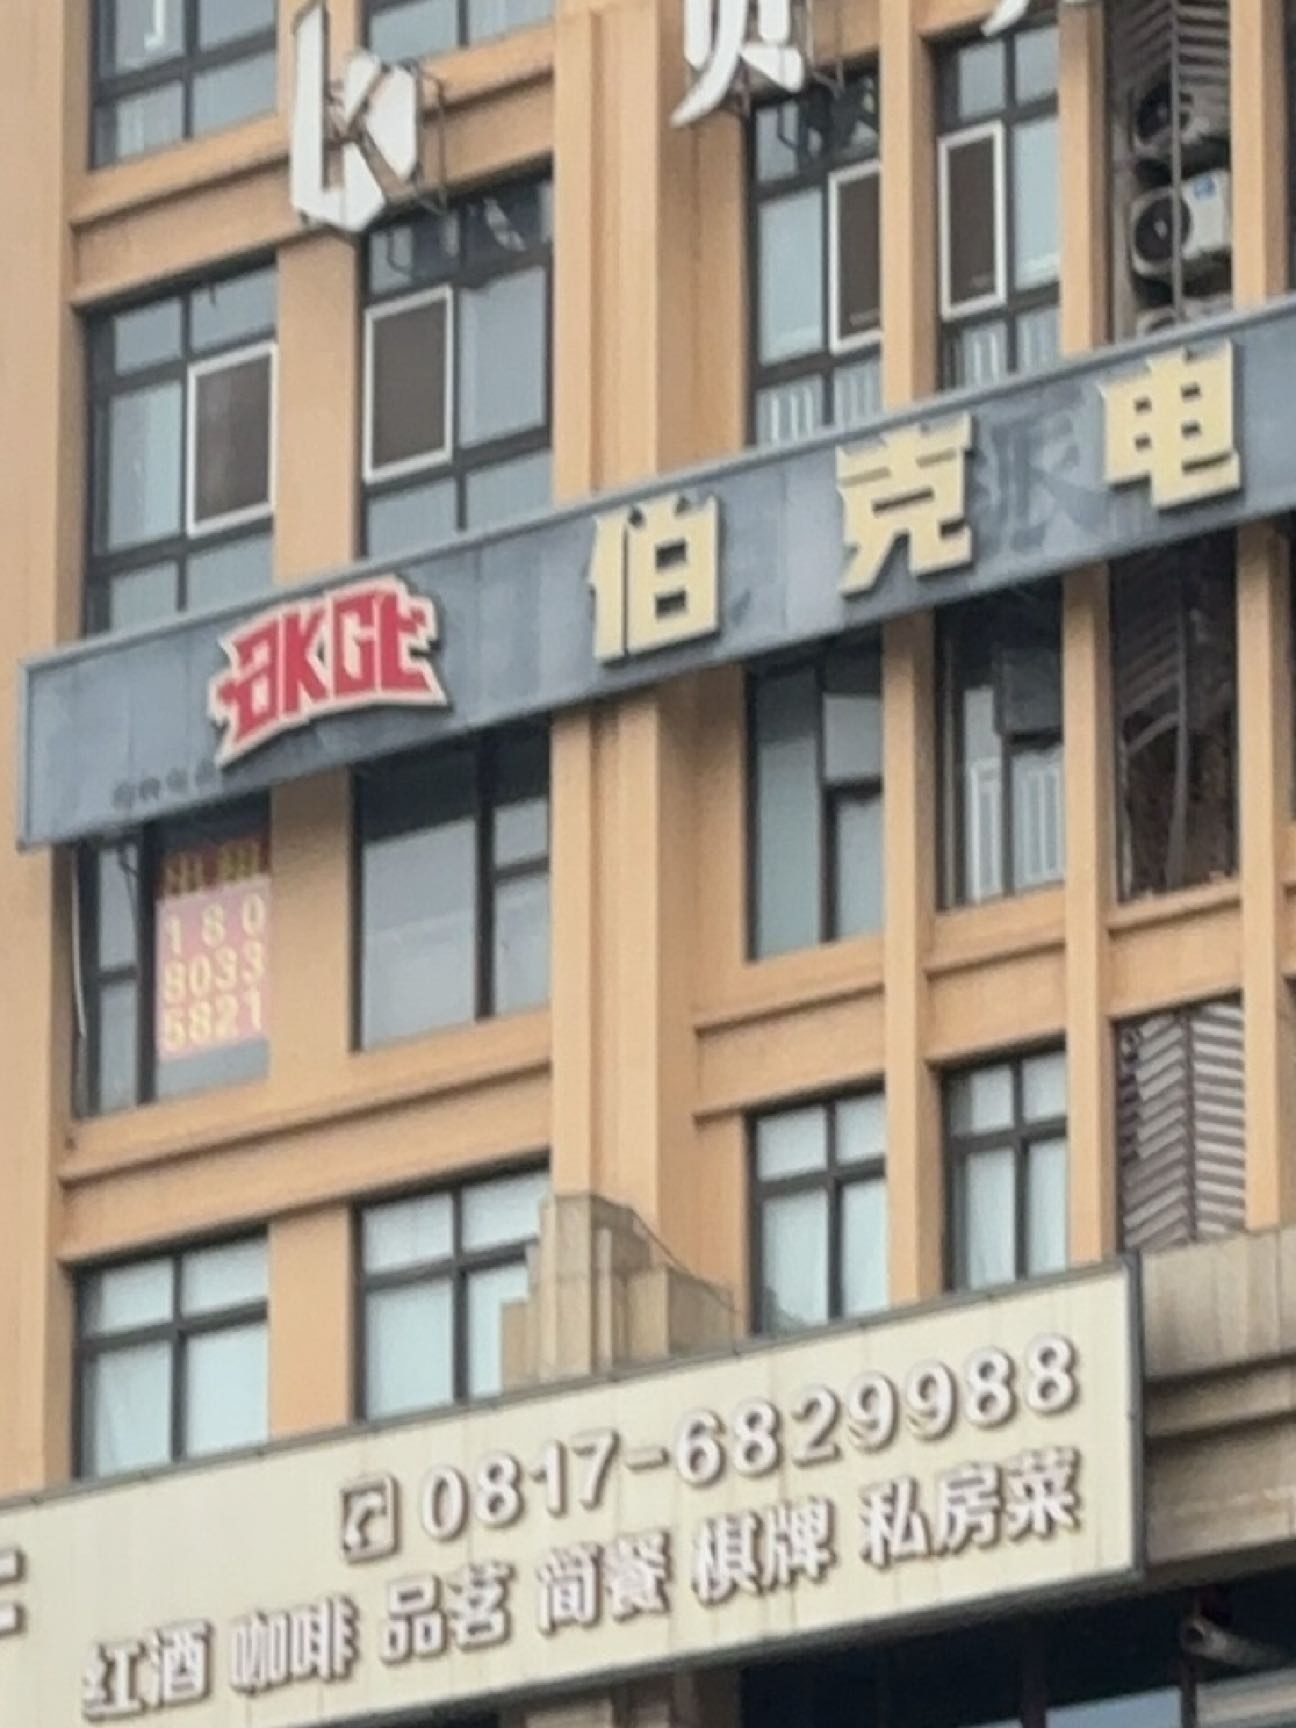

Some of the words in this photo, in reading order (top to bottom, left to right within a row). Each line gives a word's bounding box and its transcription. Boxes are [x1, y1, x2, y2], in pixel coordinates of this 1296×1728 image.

[588, 338, 1240, 664] 伯克电
[419, 1334, 1078, 1541] 0817-6829988
[82, 1618, 210, 1721] 红酒
[230, 1595, 361, 1695] 咖啡
[380, 1562, 511, 1665] 品茗
[536, 1534, 672, 1634] 简餐
[691, 1496, 836, 1604] 棋牌
[859, 1447, 1080, 1569] 私房菜
